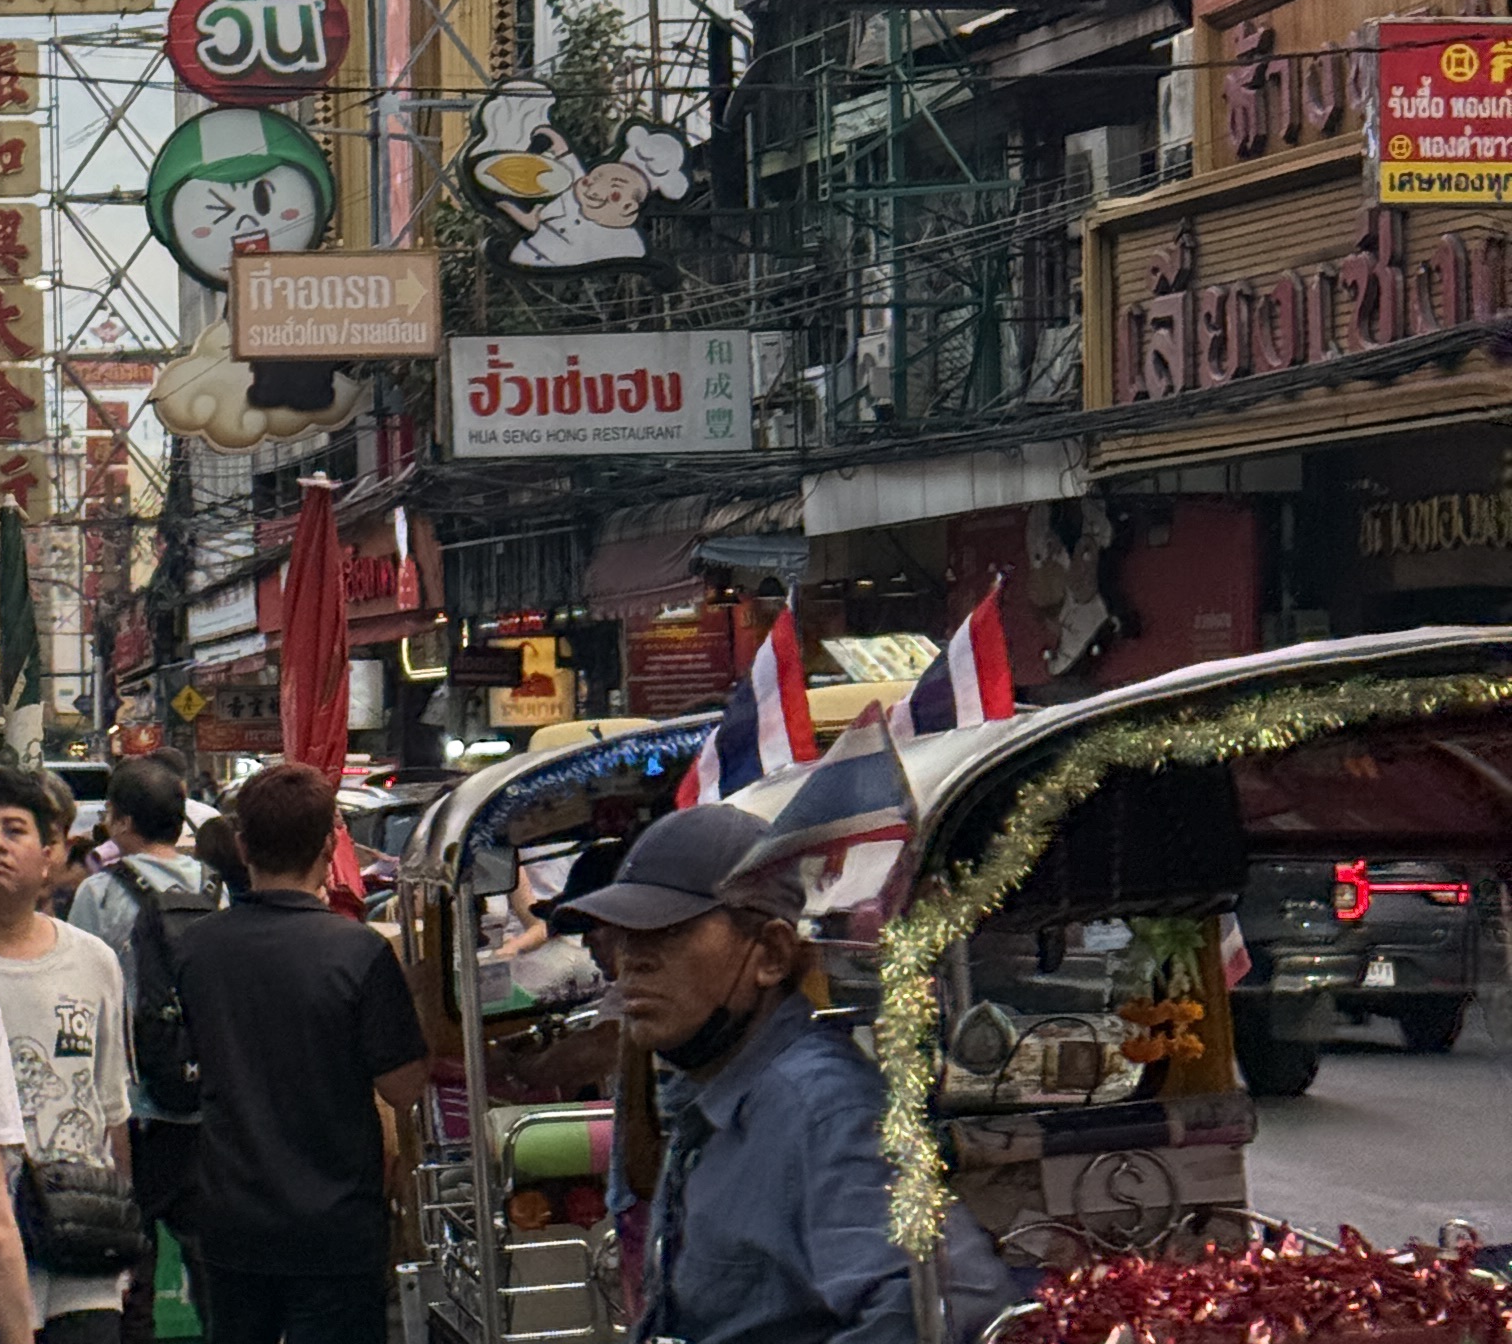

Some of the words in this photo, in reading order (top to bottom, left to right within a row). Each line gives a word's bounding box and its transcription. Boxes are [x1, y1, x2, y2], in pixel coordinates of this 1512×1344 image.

[1388, 75, 1444, 119] รับซื้อ
[248, 261, 391, 311] ที่จอดรถ
[703, 338, 734, 441] 和成豐
[469, 430, 498, 445] HUA
[502, 428, 542, 445] SENG
[546, 427, 588, 443] HONG
[592, 424, 684, 442] RESTAURANT
